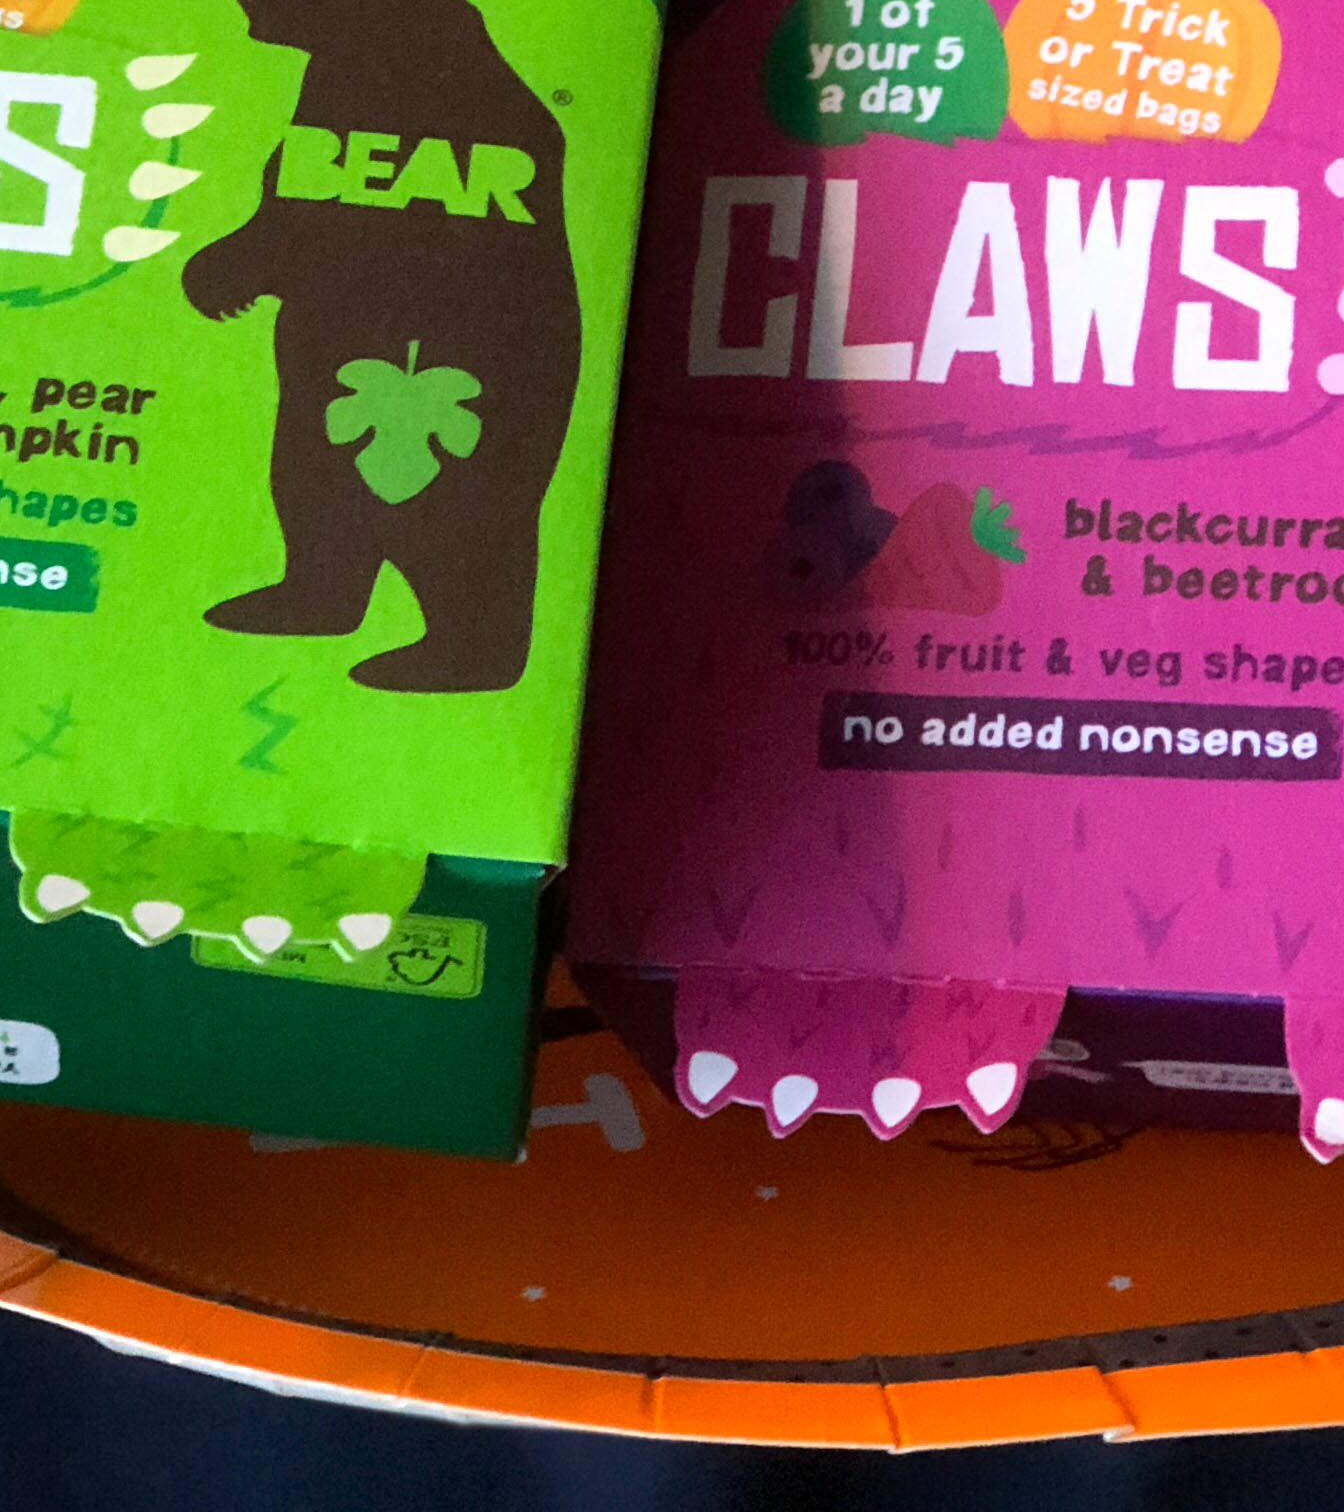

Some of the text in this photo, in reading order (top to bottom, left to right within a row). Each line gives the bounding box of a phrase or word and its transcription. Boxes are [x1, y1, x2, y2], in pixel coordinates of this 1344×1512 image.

[806, 36, 965, 80] your 5
[1039, 35, 1235, 97] or Treat
[818, 78, 943, 123] a day
[1027, 75, 1223, 135] sized bags
[275, 124, 537, 225] BEAR
[687, 175, 1300, 393] CLAWS
[29, 373, 158, 416] pear
[1080, 554, 1115, 598] &
[780, 629, 894, 667] 100%
[913, 633, 1027, 675] fruit
[1045, 637, 1074, 676] &
[1099, 645, 1183, 687] veg
[842, 712, 1320, 760] no added nonsense
[5, 1045, 20, 1057] a
